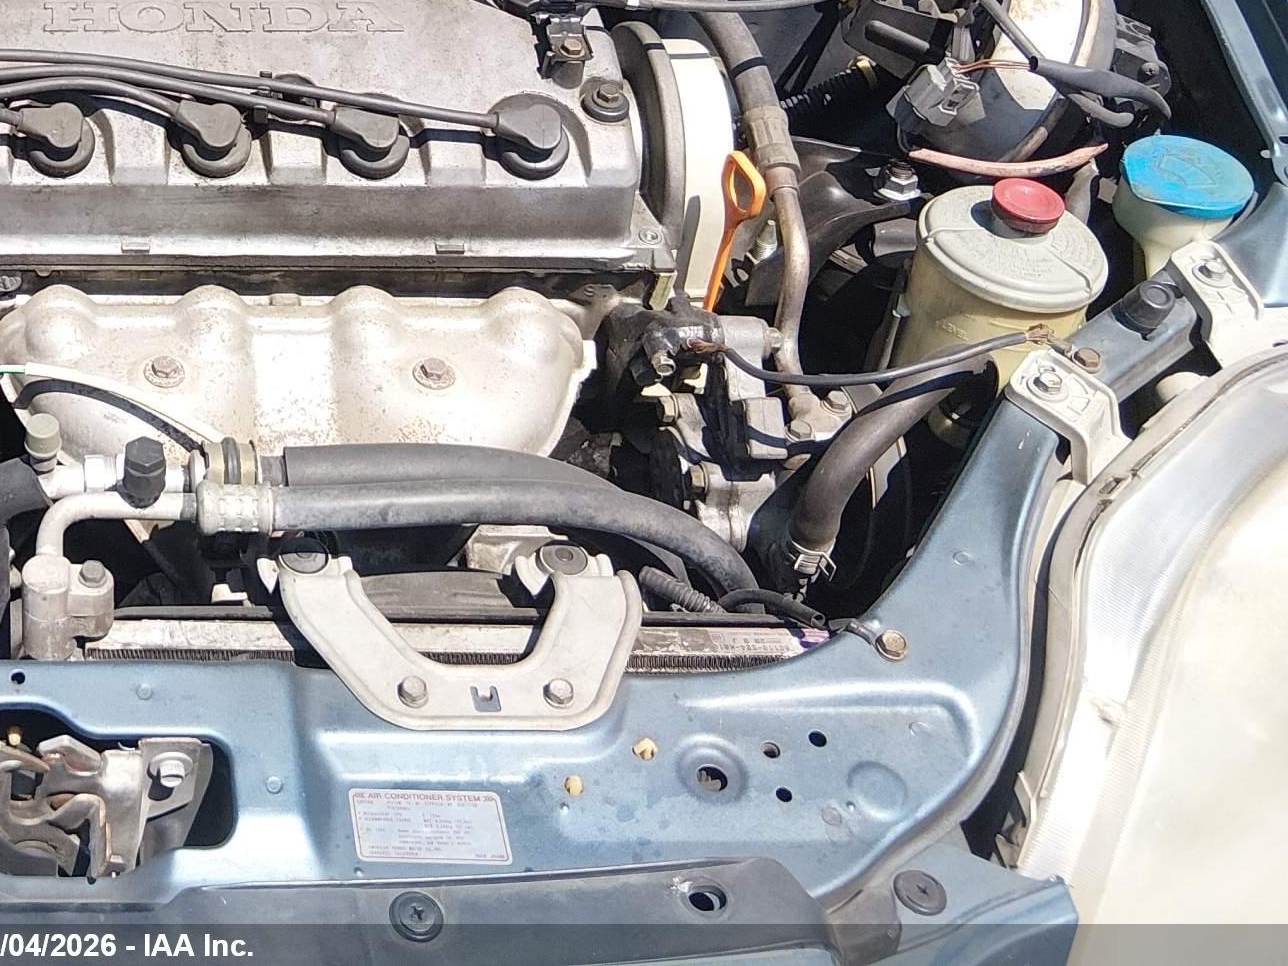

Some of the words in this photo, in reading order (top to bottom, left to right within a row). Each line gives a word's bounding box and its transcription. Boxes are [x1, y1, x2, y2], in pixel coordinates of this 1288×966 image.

[43, 1, 405, 33] HONDA
[384, 793, 443, 802] CONDITIONER
[446, 794, 481, 803] SYSTEM
